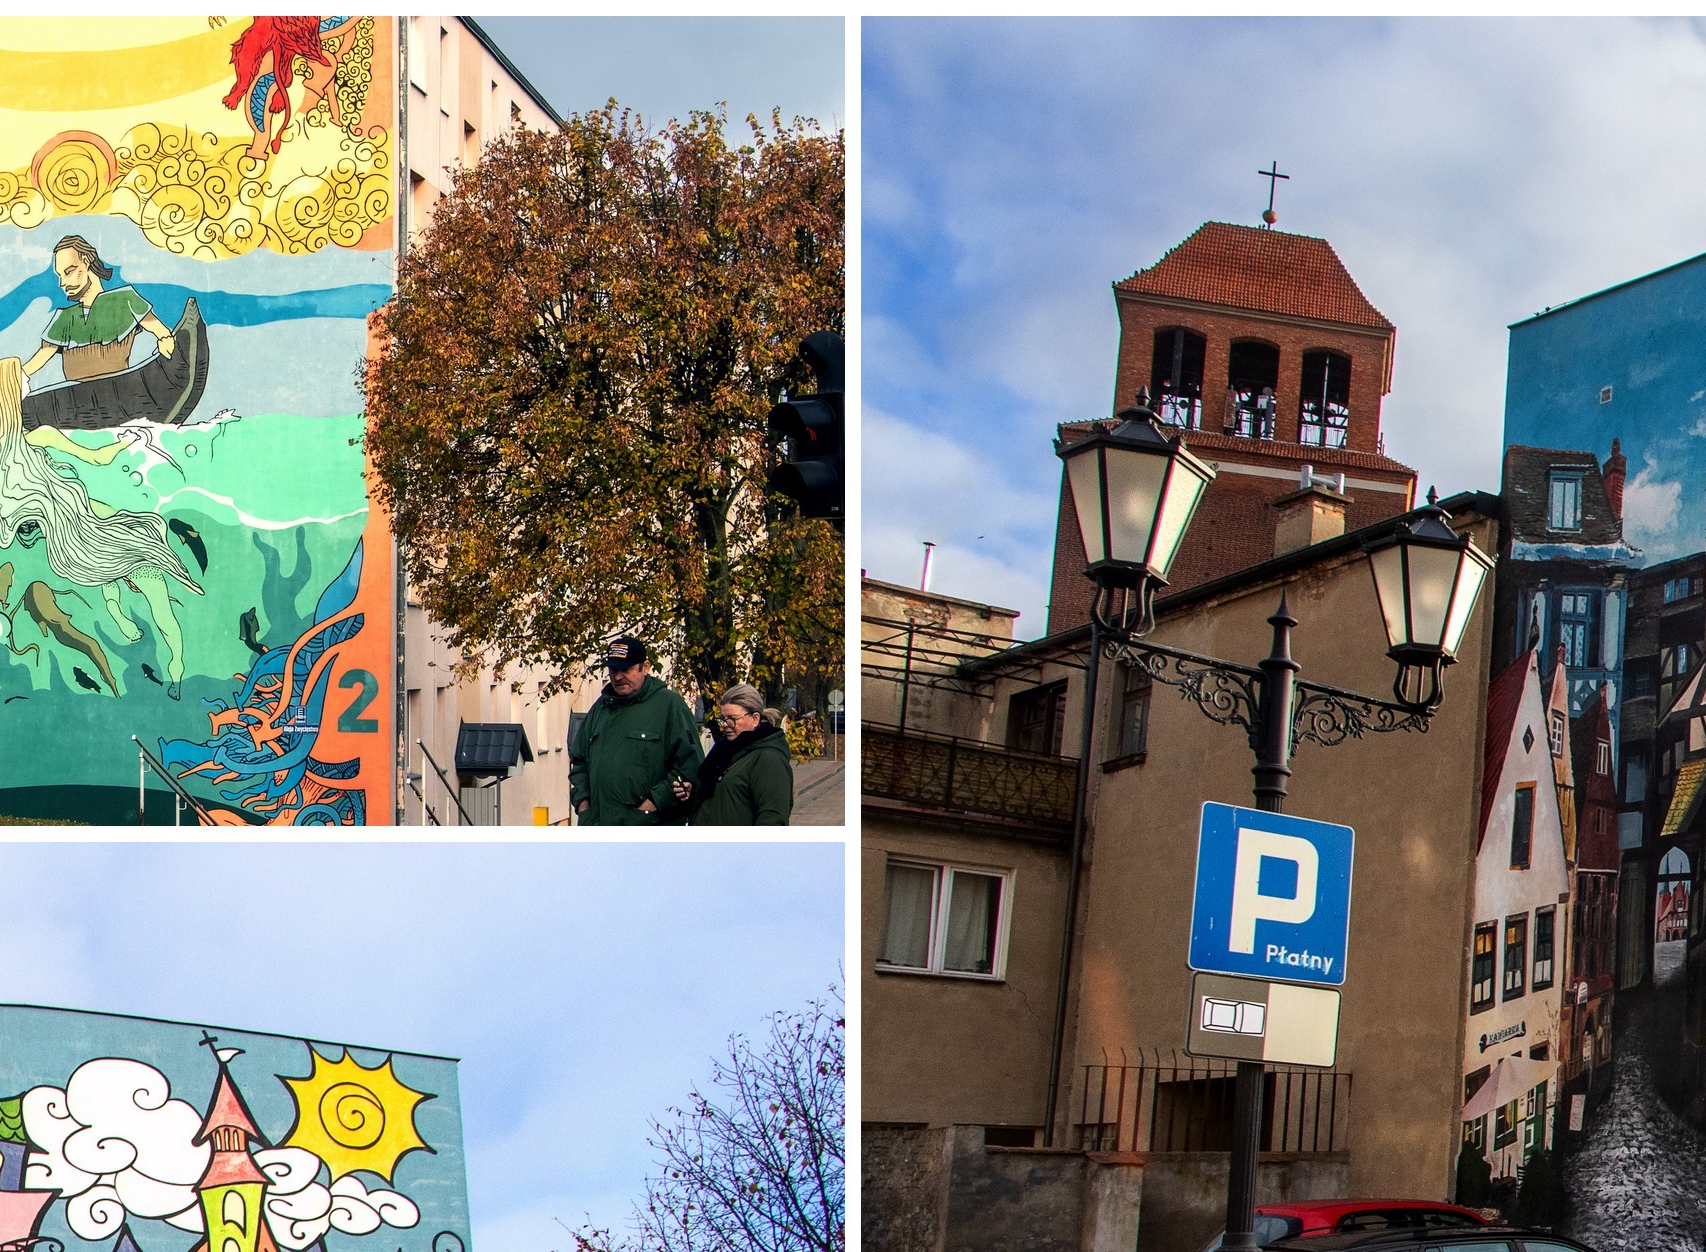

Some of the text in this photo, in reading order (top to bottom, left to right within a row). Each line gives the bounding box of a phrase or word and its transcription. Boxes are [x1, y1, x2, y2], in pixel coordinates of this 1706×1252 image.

[338, 668, 379, 733] 2
[1228, 826, 1319, 955] P
[1265, 944, 1334, 976] Płatny
